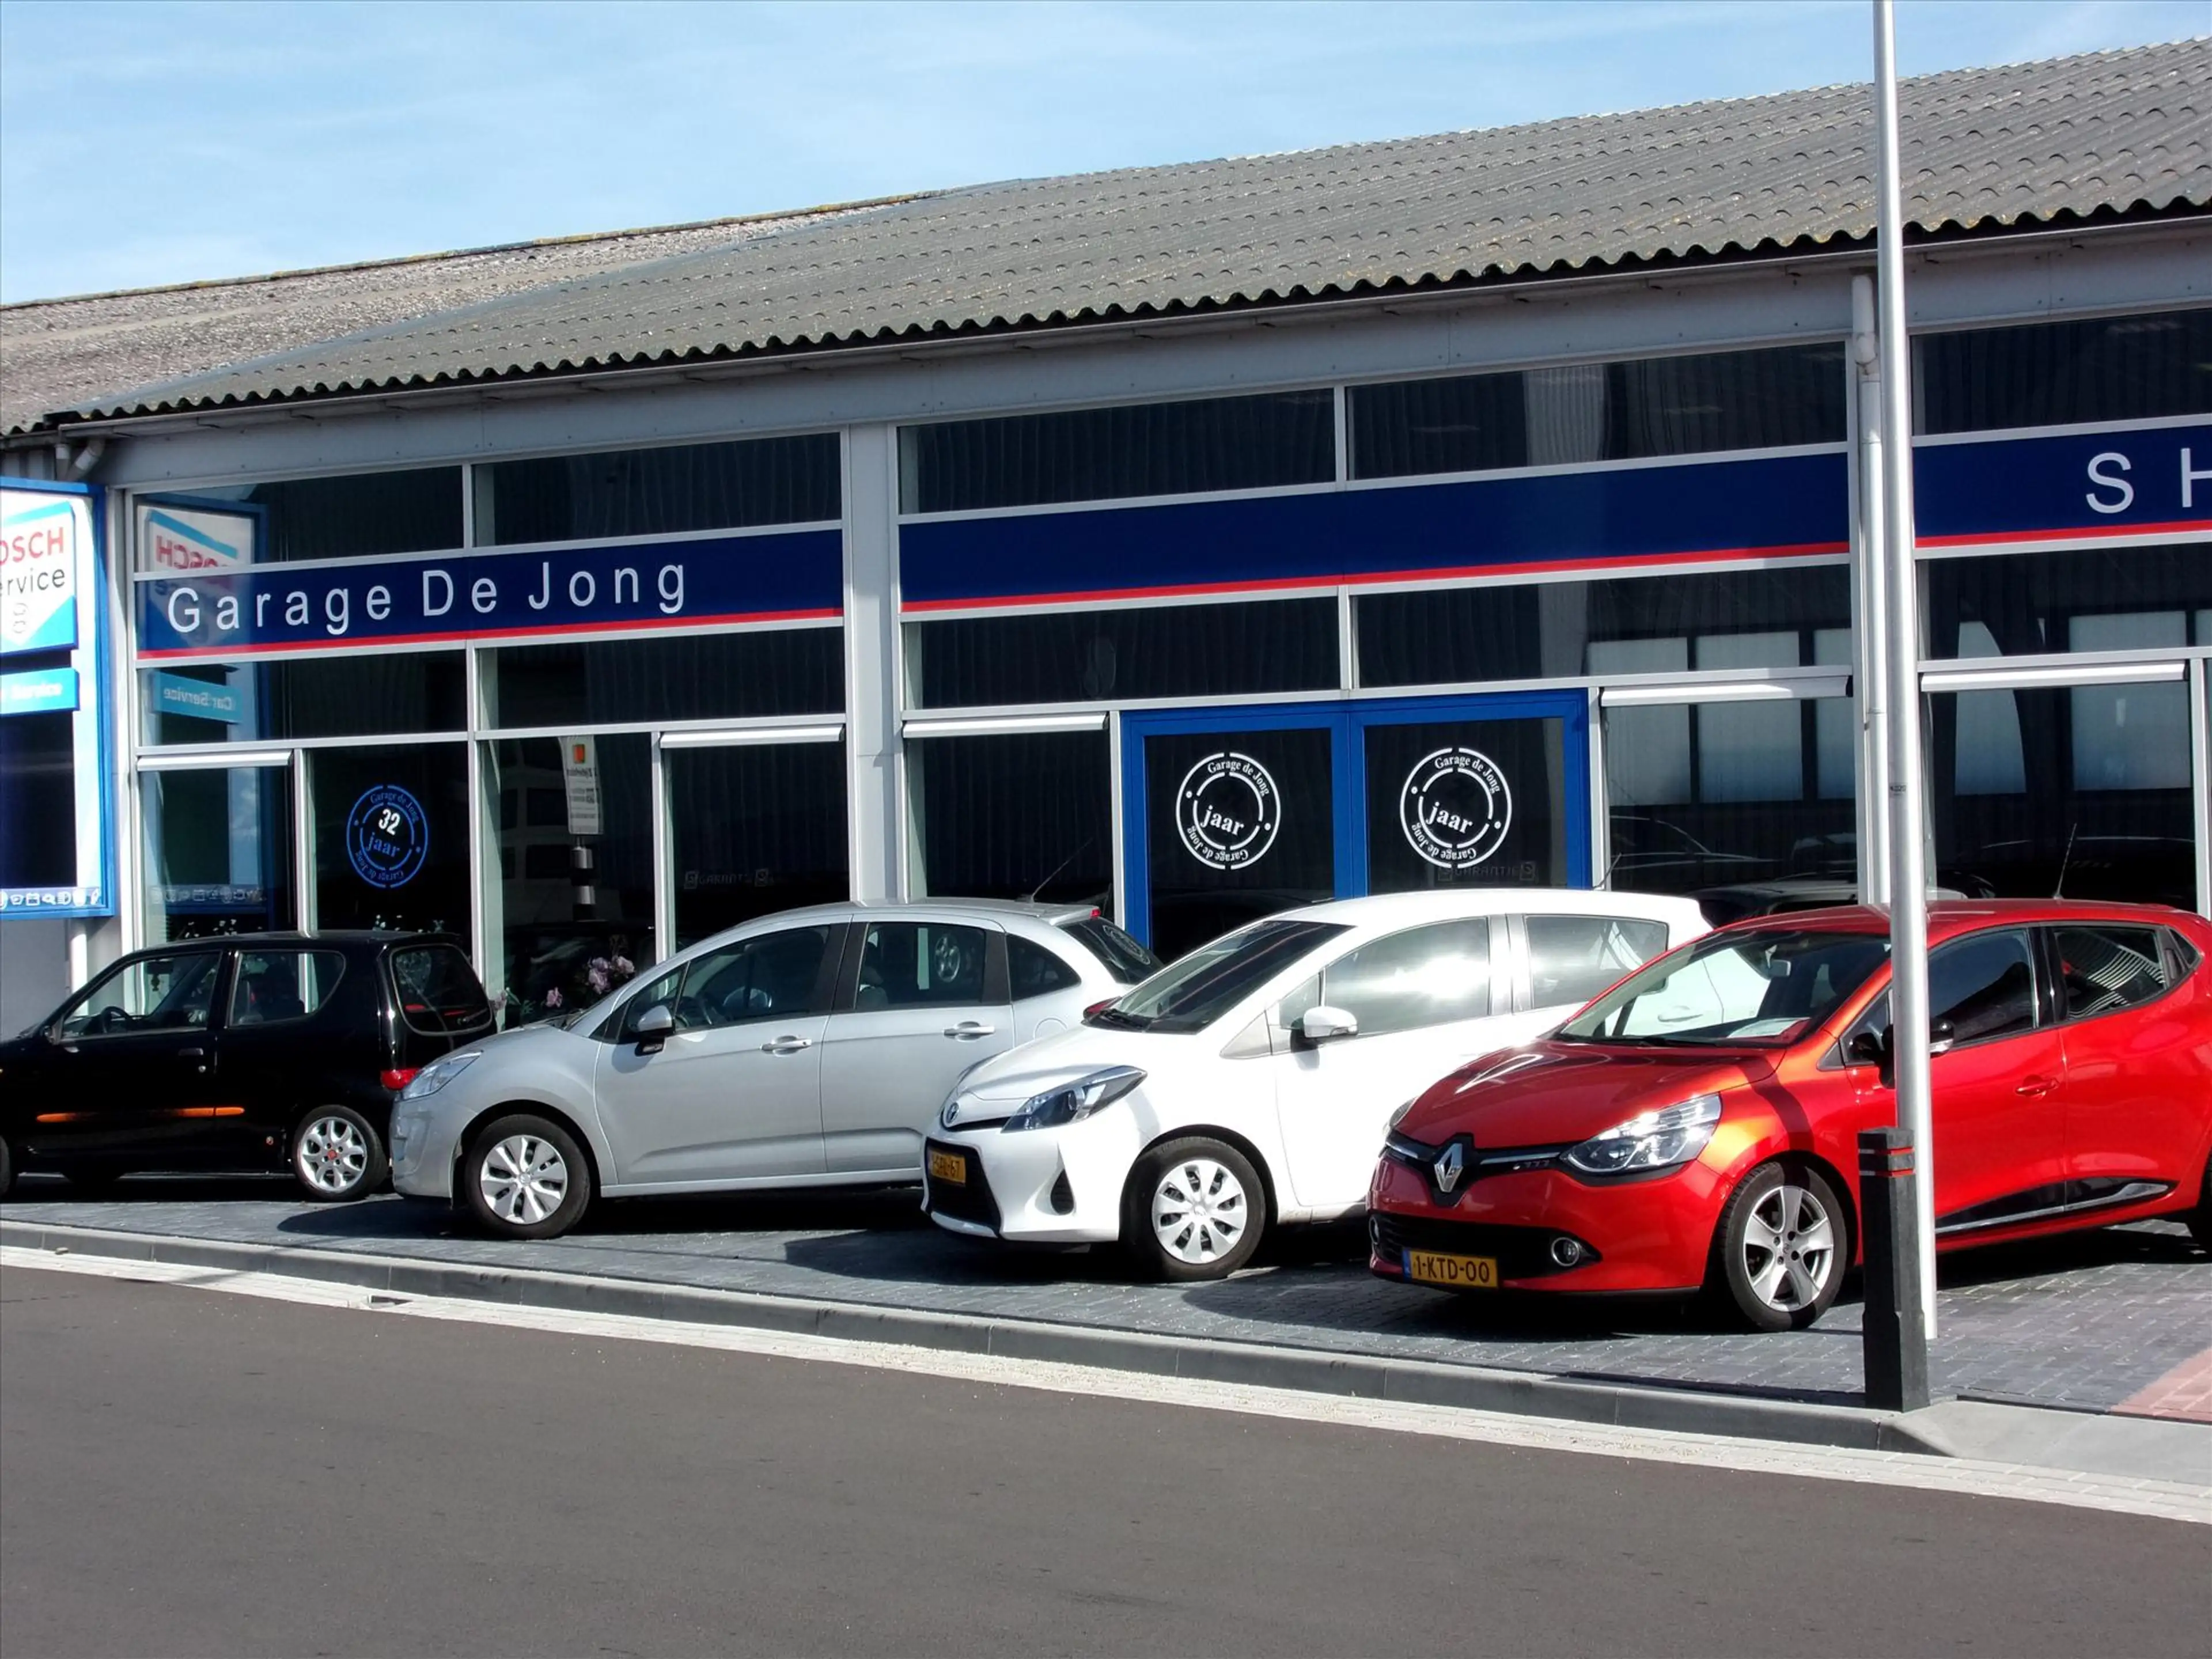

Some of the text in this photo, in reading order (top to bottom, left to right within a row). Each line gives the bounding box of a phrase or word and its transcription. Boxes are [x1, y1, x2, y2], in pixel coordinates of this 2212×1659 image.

[168, 585, 391, 635] Garage
[423, 570, 497, 616] De
[528, 562, 684, 614] Jong
[1207, 760, 1269, 797] Garage de Jong
[1434, 756, 1500, 794] Garage de Jong
[378, 808, 400, 836] 32
[1200, 805, 1244, 836] jaar
[1425, 801, 1473, 834] jaar
[366, 832, 400, 857] jaar
[1187, 825, 1249, 862] Garage de Jong
[1411, 822, 1476, 860] Garage de Jong
[1415, 1255, 1490, 1283] 1-KTD-00
